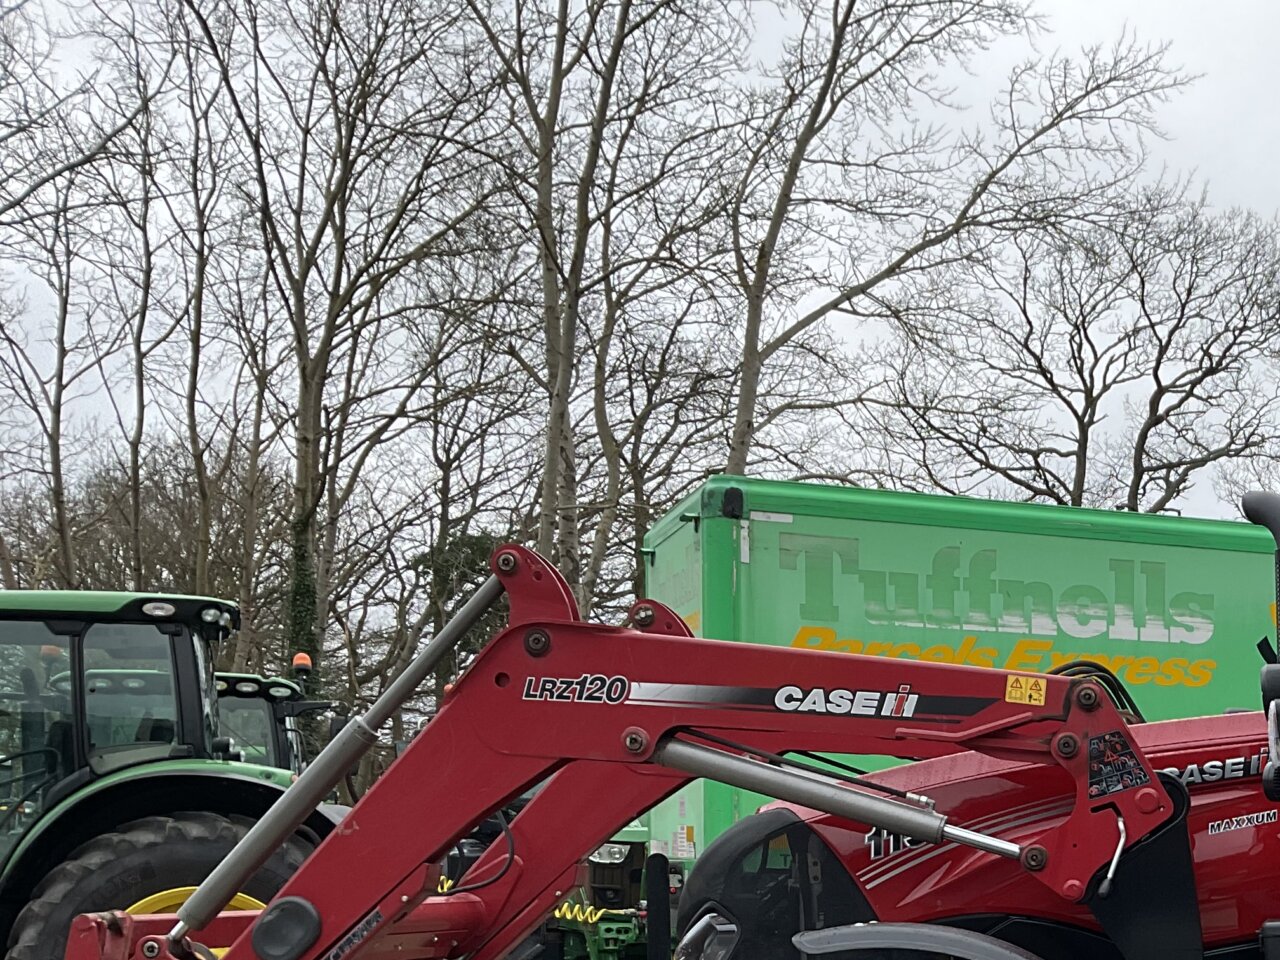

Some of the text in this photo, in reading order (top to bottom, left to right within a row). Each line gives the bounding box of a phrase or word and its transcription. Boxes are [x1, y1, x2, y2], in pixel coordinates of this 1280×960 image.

[778, 531, 1215, 645] Tuffnells
[522, 673, 628, 705] LRZ120
[774, 685, 881, 715] CASE
[1208, 809, 1278, 835] MAXXUM
